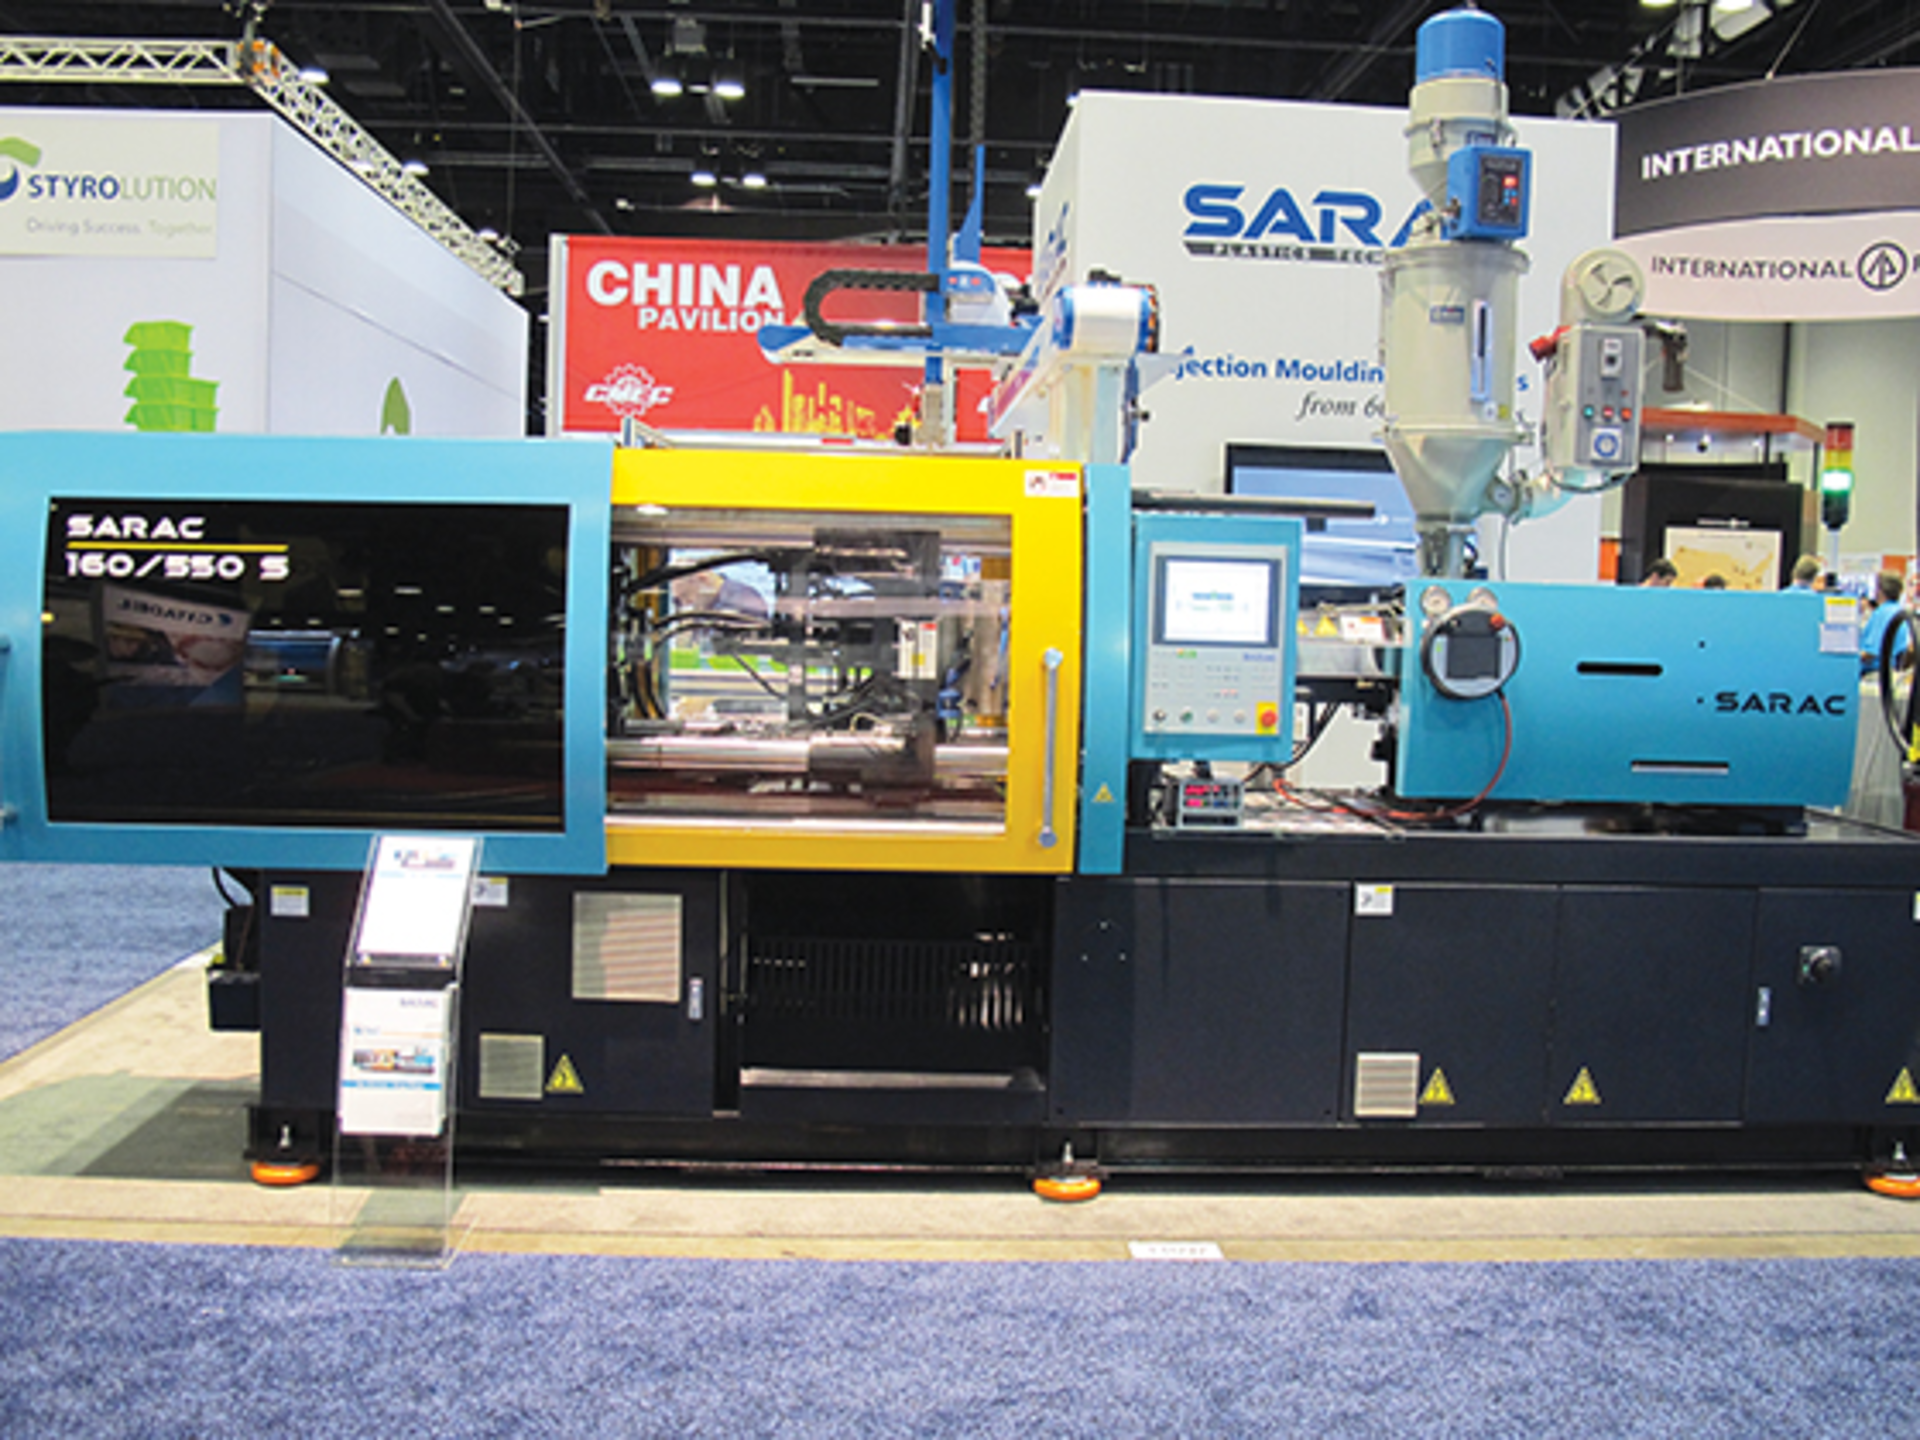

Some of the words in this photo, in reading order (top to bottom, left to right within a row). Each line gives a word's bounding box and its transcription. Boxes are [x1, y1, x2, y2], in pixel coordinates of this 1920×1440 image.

[1641, 126, 1920, 180] INTERNATIONAL
[28, 174, 217, 200] STYROLUTION
[27, 216, 79, 235] Driving
[1651, 255, 1853, 280] INTERNATIONAL
[586, 260, 785, 308] CHINA
[638, 306, 785, 333] PAVILION
[1295, 390, 1356, 421] from
[66, 514, 206, 539] SARAC
[65, 552, 245, 580] 160/550
[259, 555, 290, 580] S
[1714, 691, 1847, 716] SARAC
